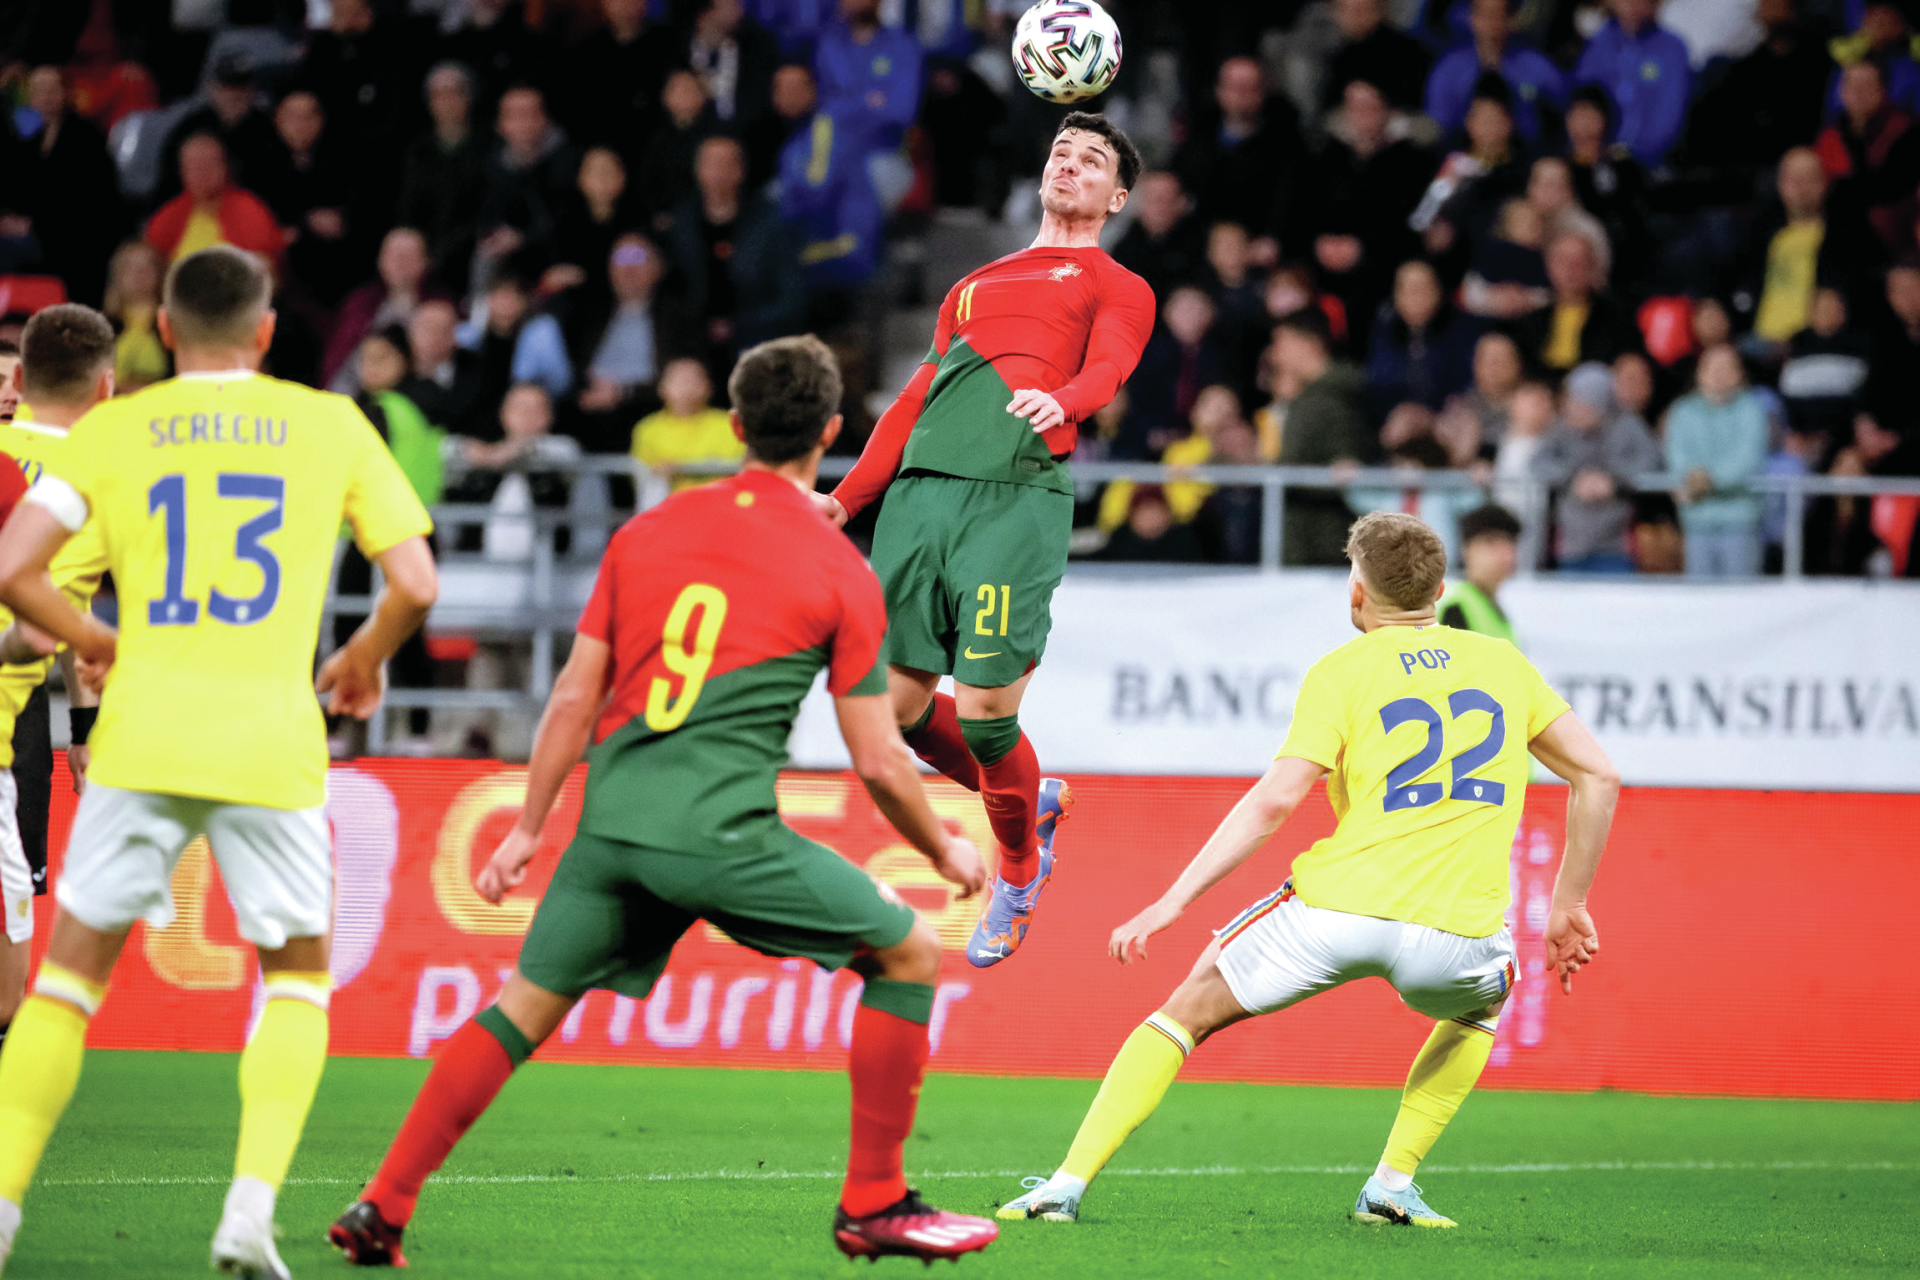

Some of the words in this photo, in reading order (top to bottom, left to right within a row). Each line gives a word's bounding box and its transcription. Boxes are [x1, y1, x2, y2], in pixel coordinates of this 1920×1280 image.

[149, 413, 288, 448] SCRECIU
[148, 473, 285, 626] 13
[975, 584, 1010, 636] 21
[645, 583, 728, 732] 9
[1399, 649, 1451, 675] POP
[1379, 688, 1506, 812] 22
